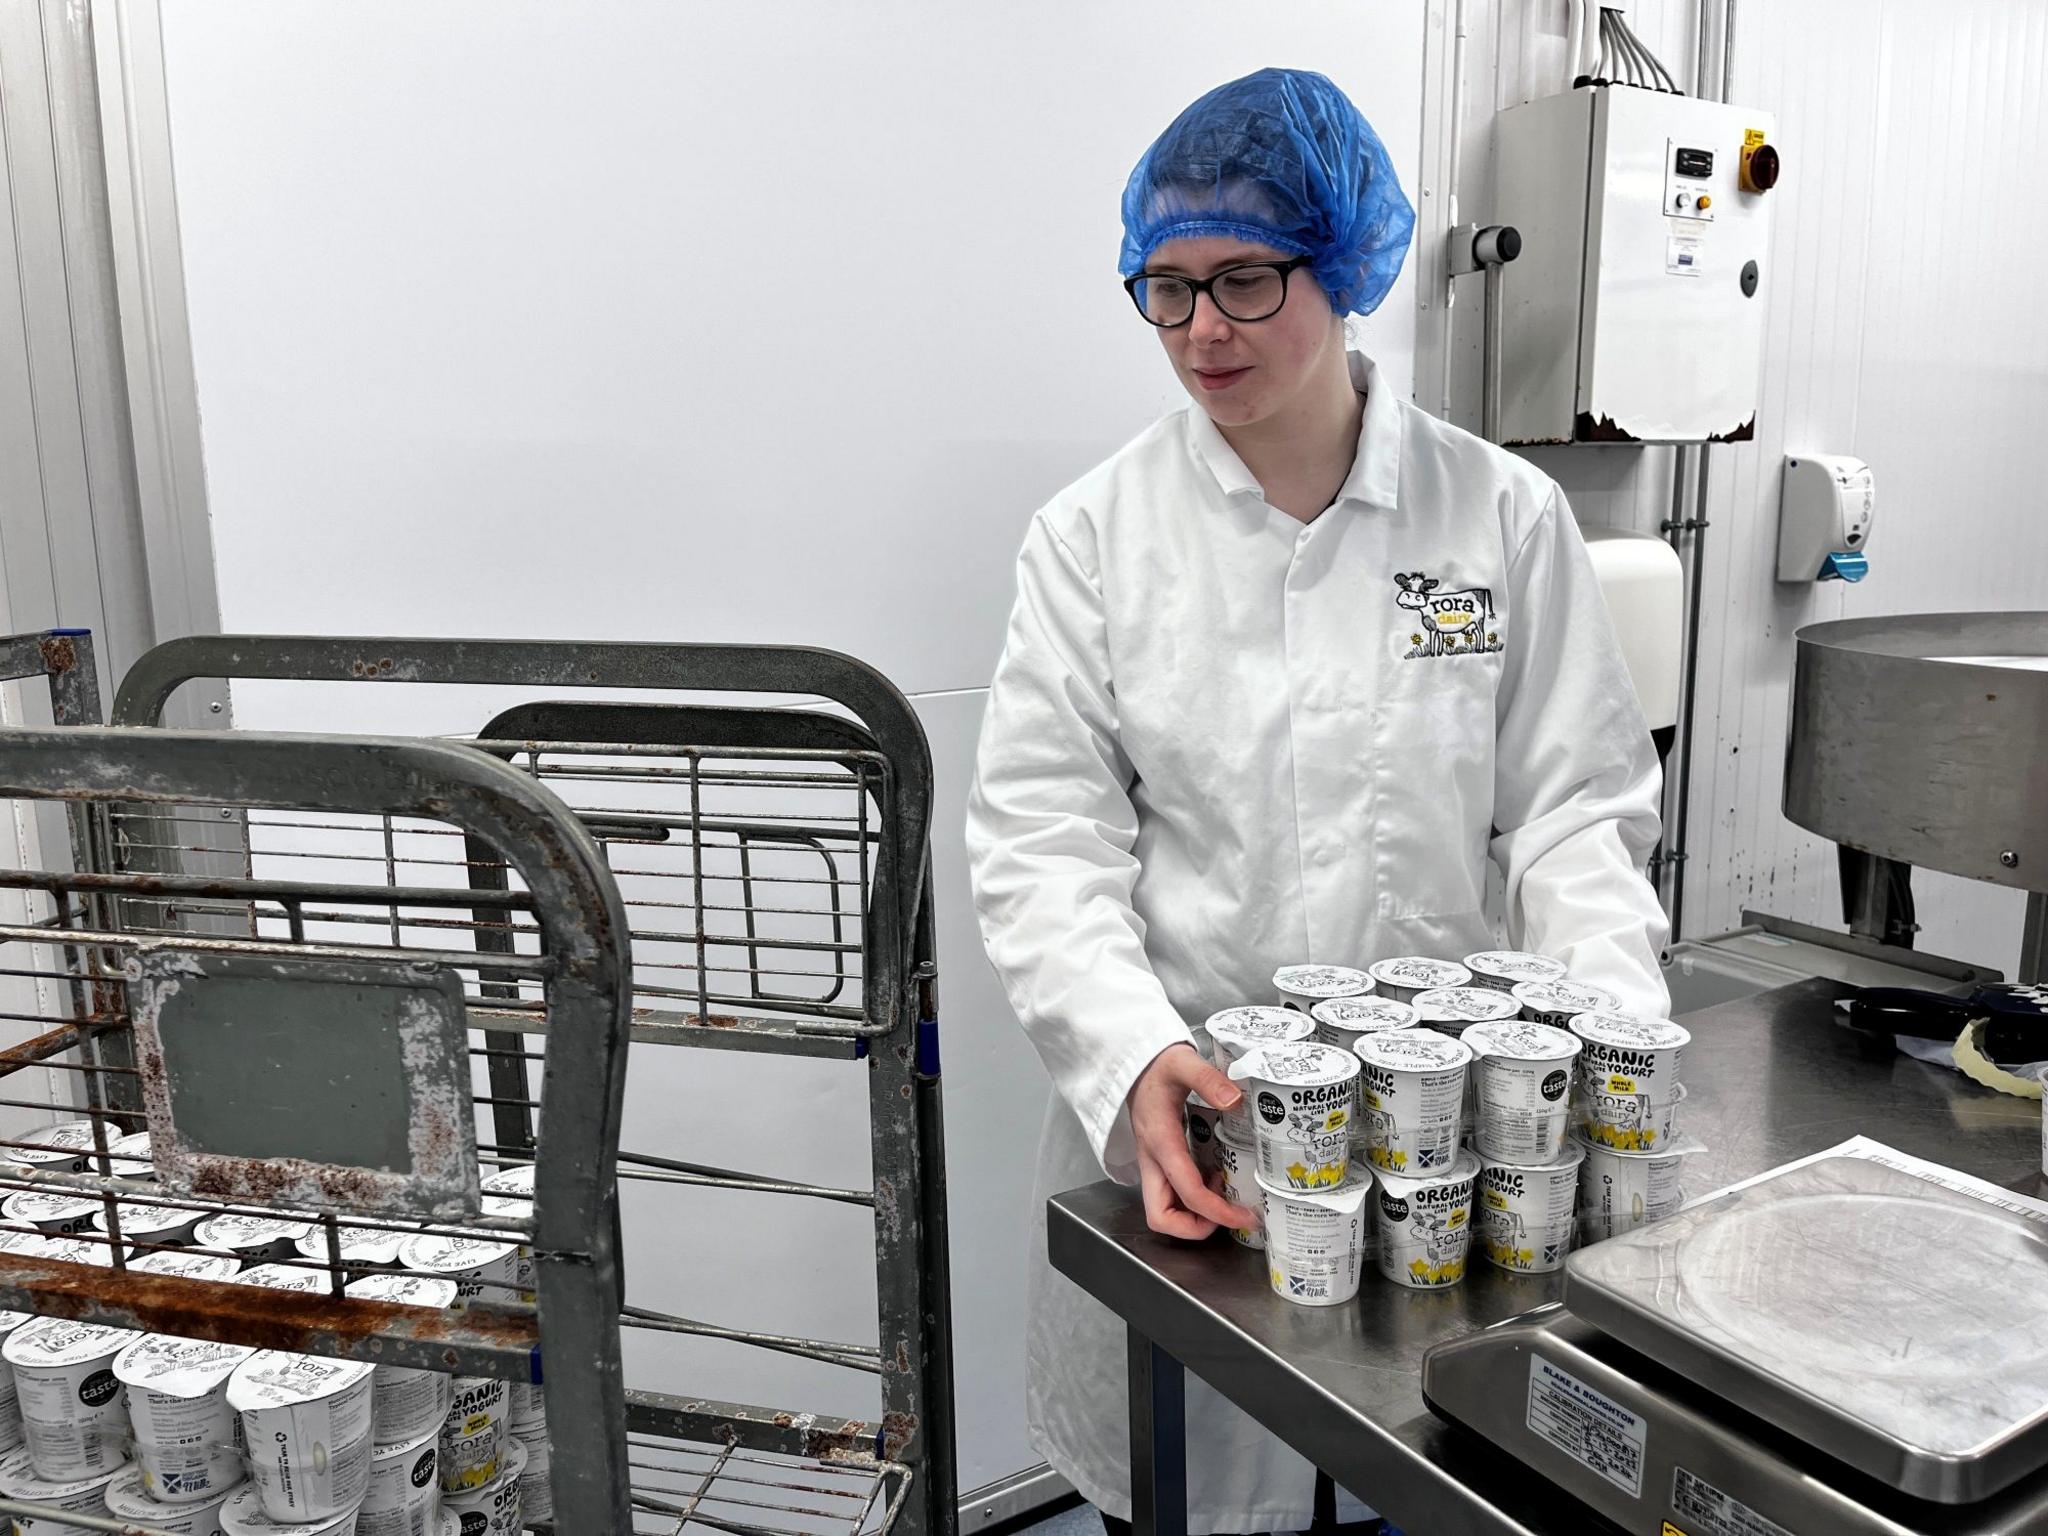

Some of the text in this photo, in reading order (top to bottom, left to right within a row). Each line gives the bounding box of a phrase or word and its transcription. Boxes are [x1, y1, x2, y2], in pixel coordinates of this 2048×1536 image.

[1430, 598, 1475, 614] rora
[1607, 1063, 1655, 1079] YOGURT
[1260, 1103, 1284, 1115] taste
[1595, 1096, 1637, 1114] rora
[295, 1361, 328, 1377] rora
[81, 1378, 119, 1400] taste
[1543, 1365, 1635, 1426] BLAKE & BOUGHTON
[462, 1391, 503, 1417] YOGURT
[1548, 1391, 1623, 1440] CALIBRATION DETAILS
[461, 1518, 487, 1533] aste
